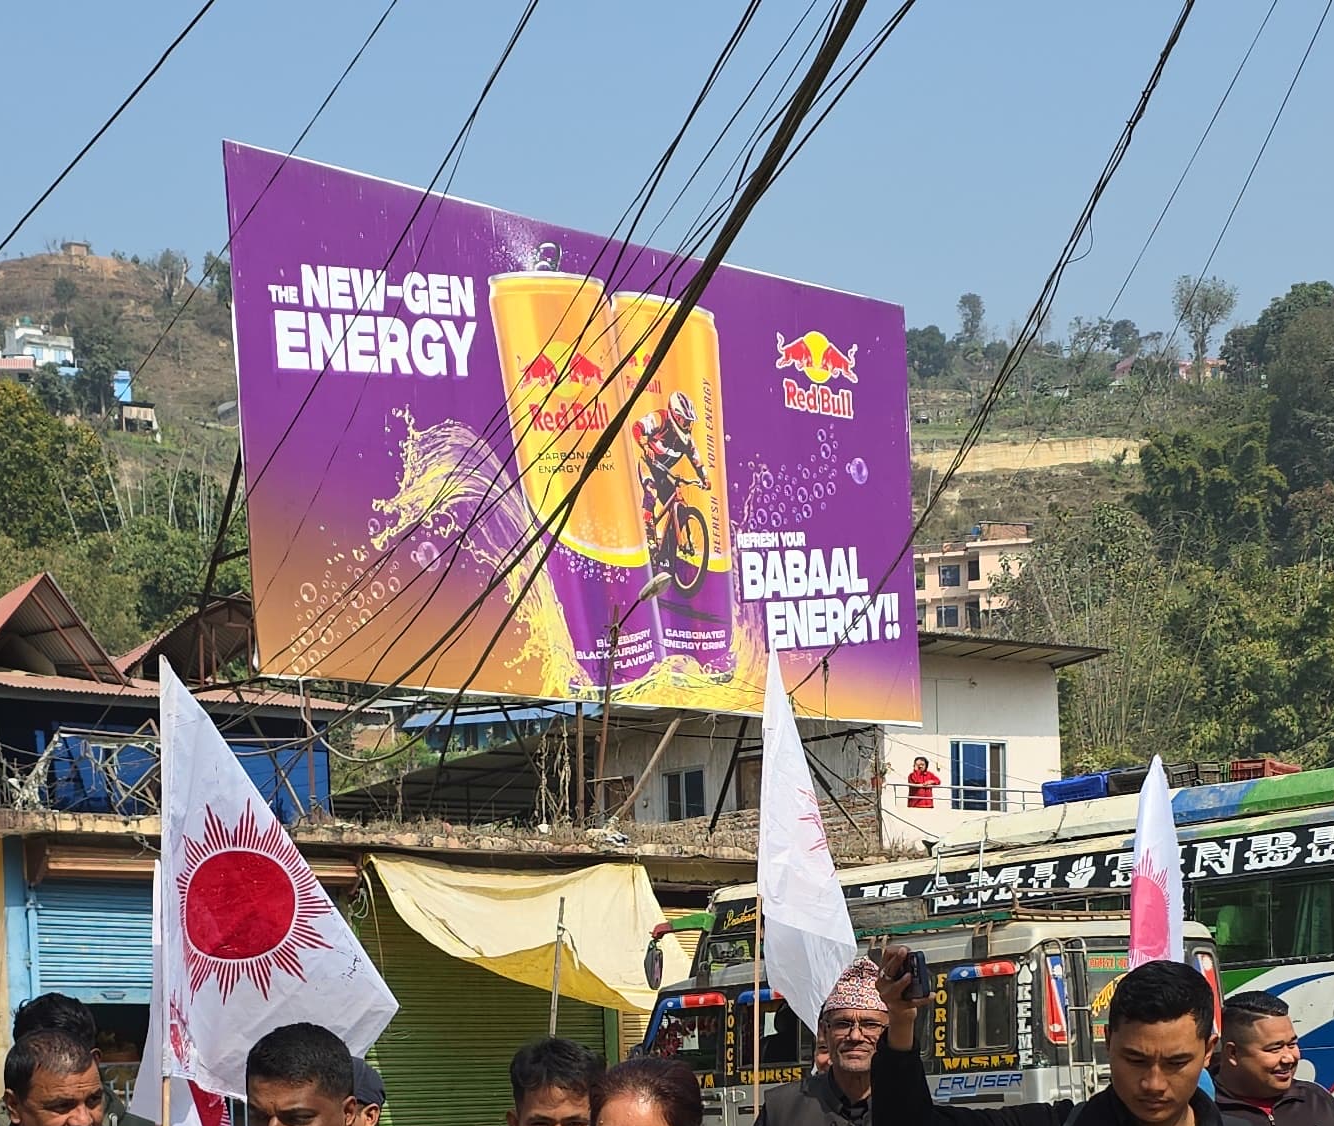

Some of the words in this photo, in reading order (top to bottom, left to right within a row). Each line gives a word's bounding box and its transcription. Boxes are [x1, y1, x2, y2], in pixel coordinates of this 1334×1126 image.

[268, 284, 299, 304] THE
[301, 263, 476, 317] NEW-GEN
[273, 309, 477, 377] ENERGY
[702, 377, 714, 430] ENERGY
[783, 378, 819, 413] Red
[819, 385, 854, 419] Bull
[529, 402, 569, 432] Red
[572, 402, 610, 432] Bull
[538, 464, 582, 474] ENERGY
[737, 533, 779, 549] REFRESH
[780, 532, 806, 547] YOUR
[741, 546, 869, 600] BABAAL
[665, 628, 726, 639] CARBONATED
[766, 592, 901, 650] ENERGY!!
[613, 651, 656, 670] FLAVOUR
[664, 639, 700, 650] ENERGY
[701, 640, 727, 650] DRINK
[934, 973, 948, 1057] FORCE
[726, 999, 736, 1076] FORCE
[943, 1054, 1018, 1070] VISIT
[938, 1073, 1024, 1091] CRUISER
